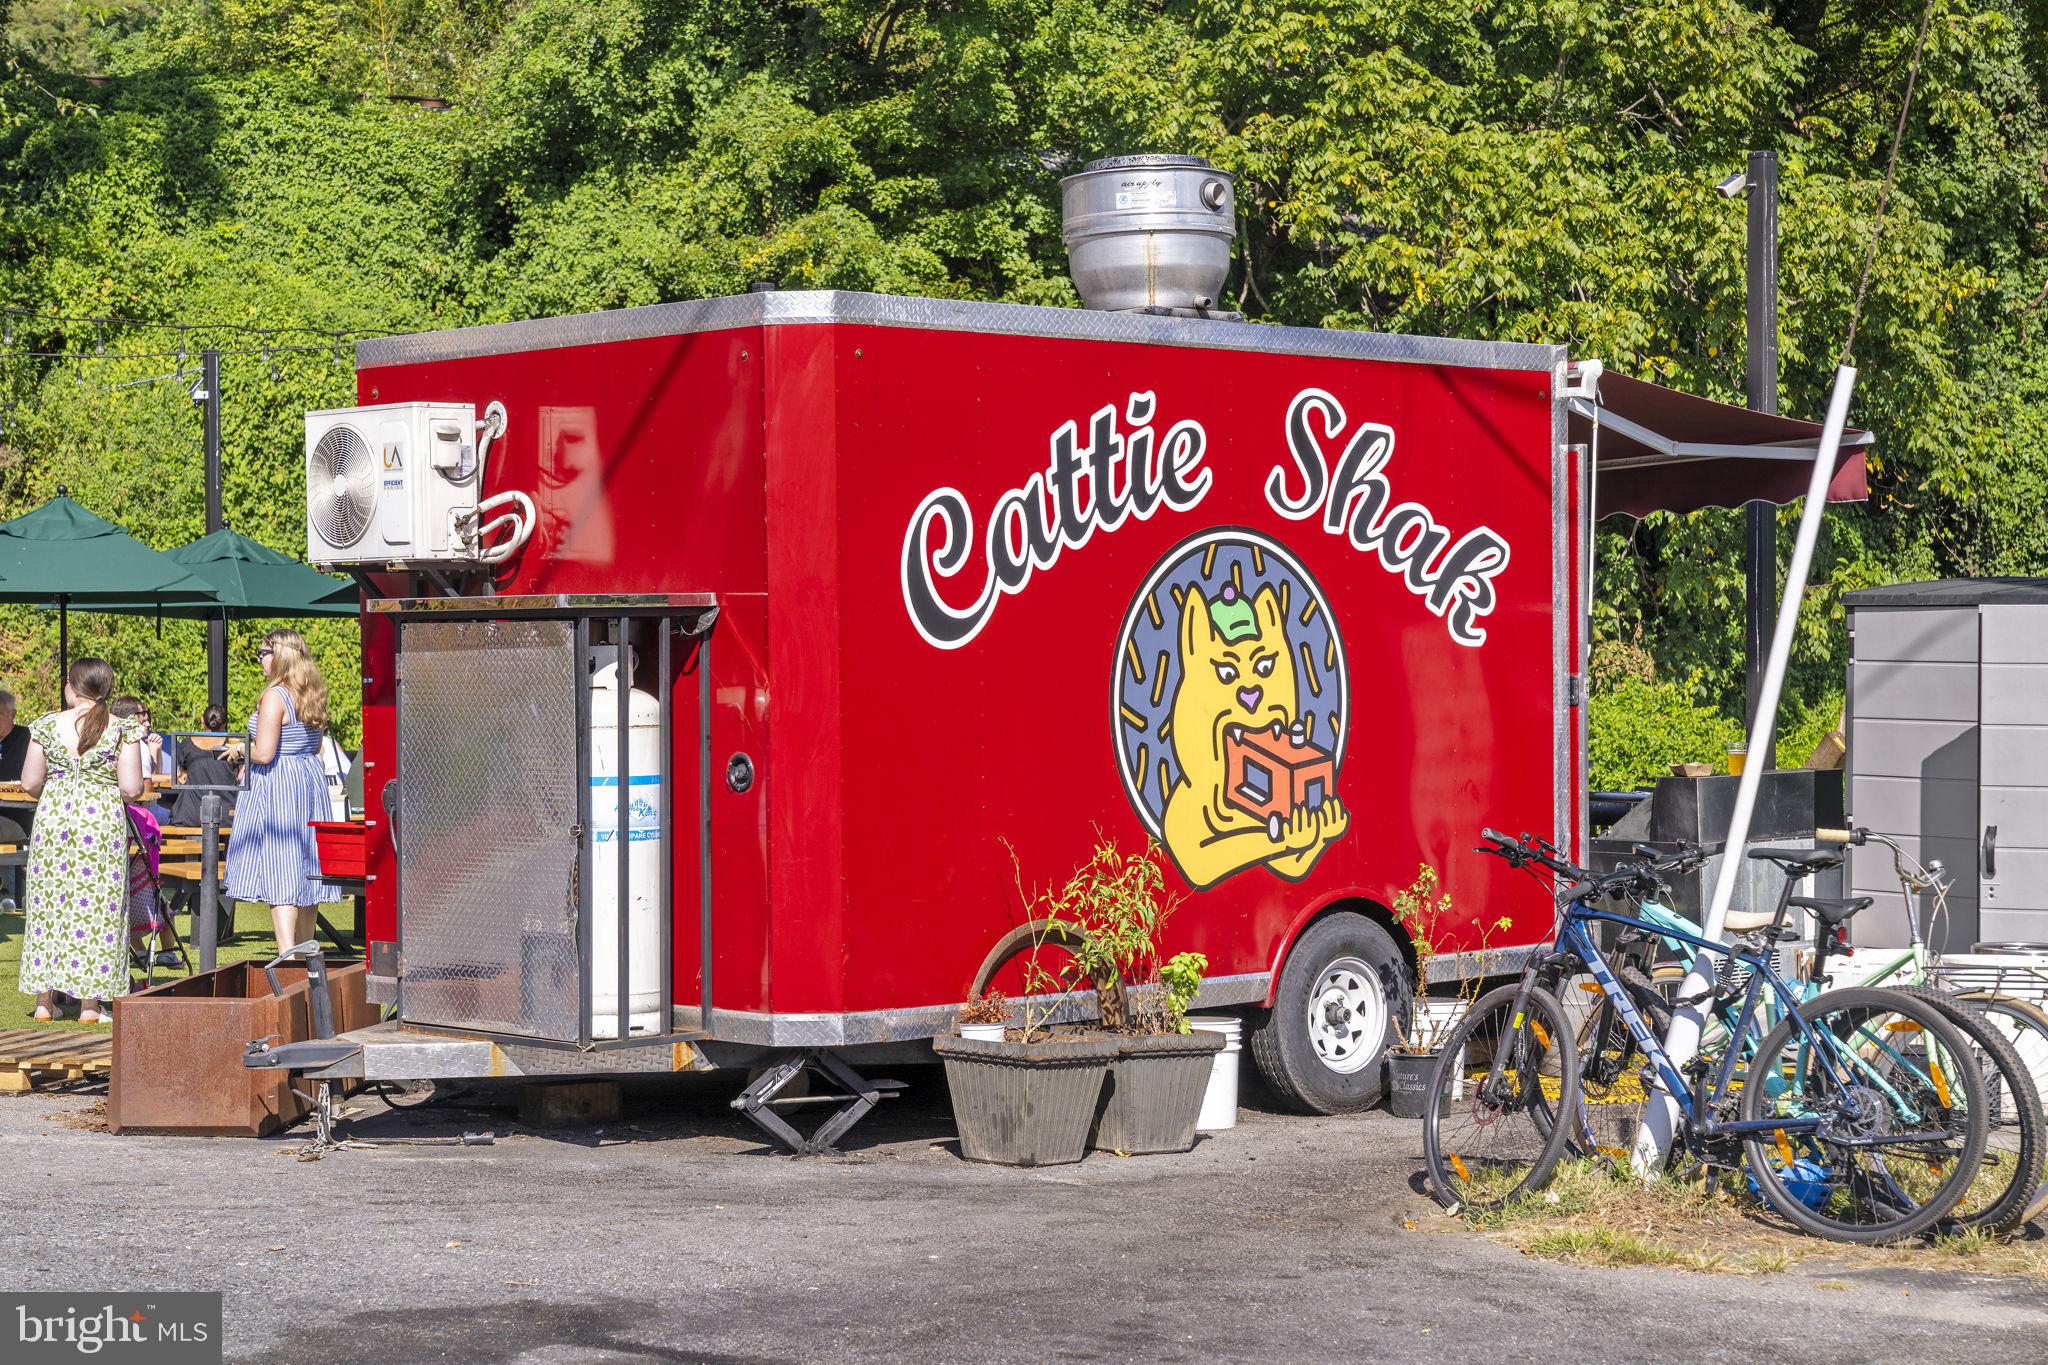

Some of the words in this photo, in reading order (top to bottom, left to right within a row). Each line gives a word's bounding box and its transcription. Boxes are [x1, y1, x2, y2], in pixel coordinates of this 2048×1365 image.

[901, 389, 1212, 650] Cattie
[1264, 387, 1511, 647] Shak
[1587, 939, 1677, 1077] TREK
